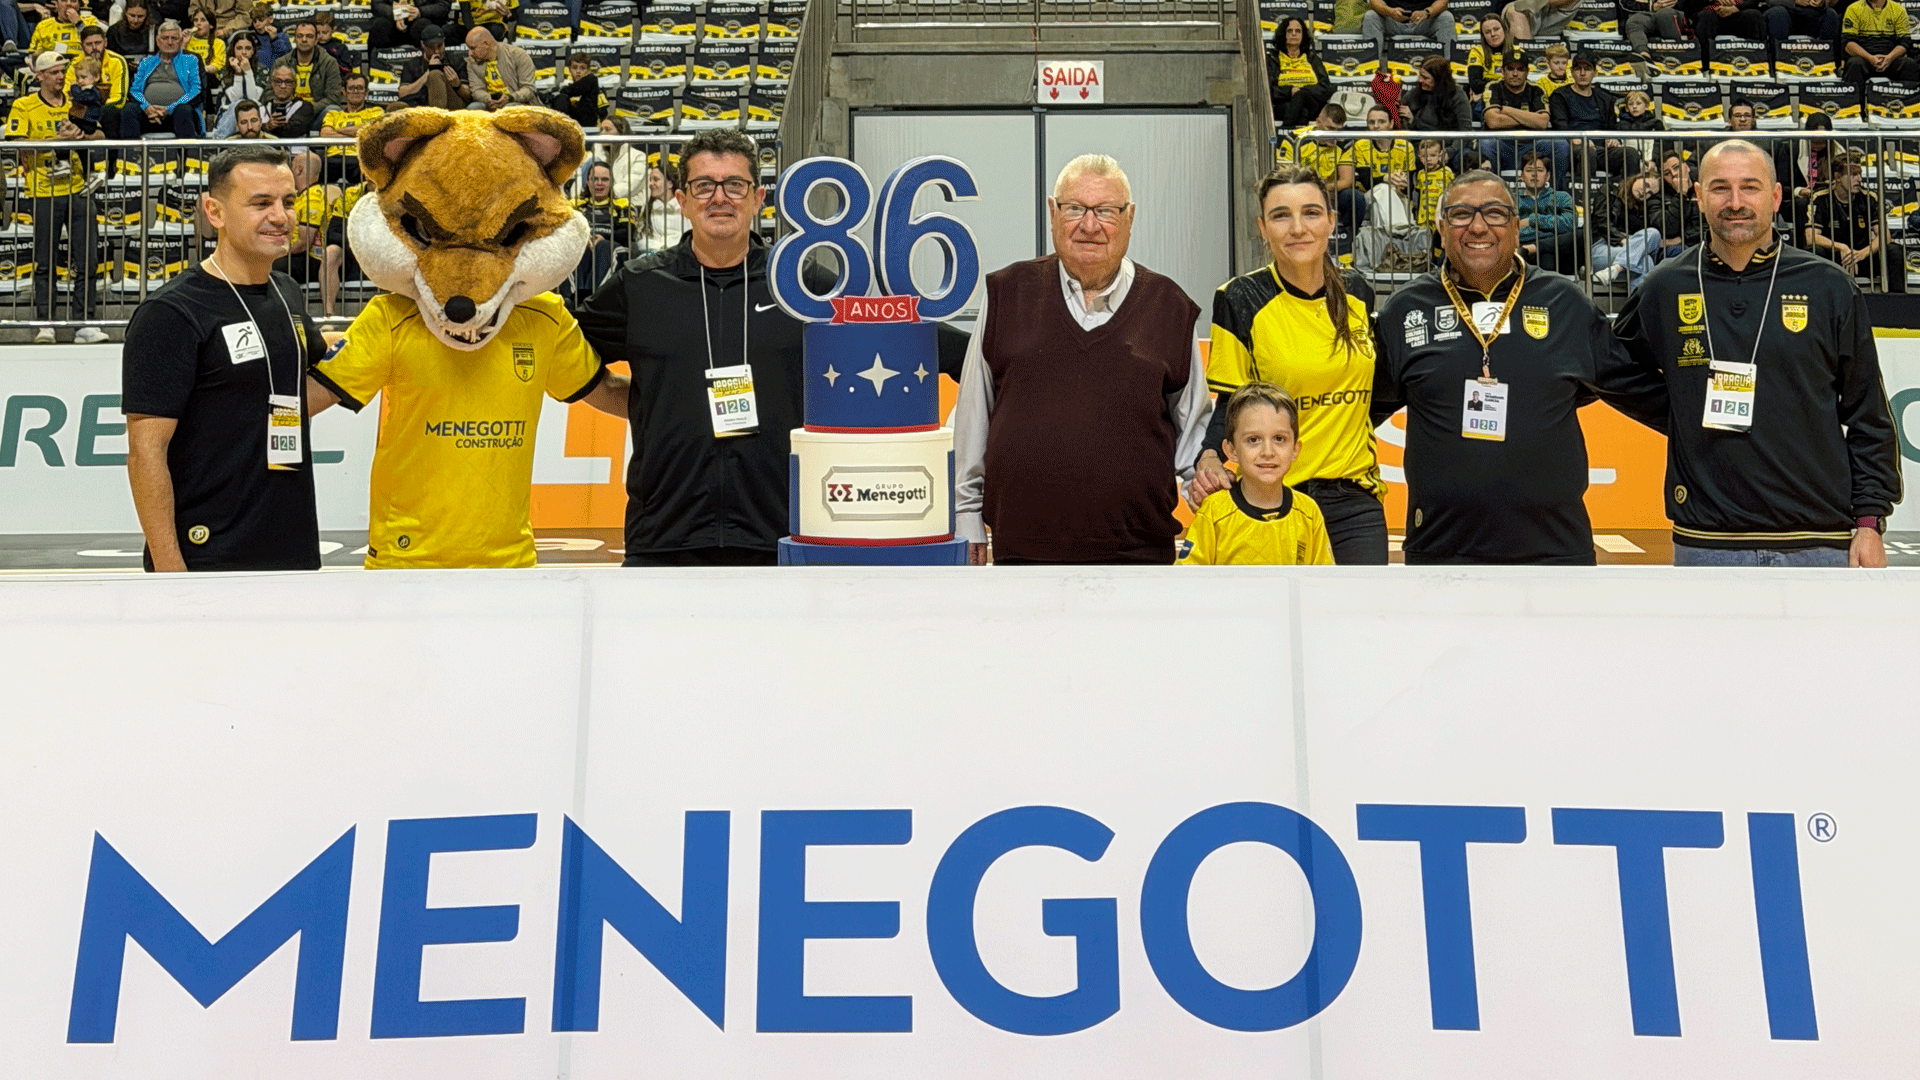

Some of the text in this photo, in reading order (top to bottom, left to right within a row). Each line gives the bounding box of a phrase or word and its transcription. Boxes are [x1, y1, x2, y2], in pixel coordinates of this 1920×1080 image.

[700, 46, 746, 54] RESERVADO
[1327, 42, 1374, 50] RESERVADO
[1781, 42, 1830, 50] RESERVADO
[1042, 66, 1099, 87] SAIDA
[622, 89, 670, 98] RESERVADO
[1669, 86, 1717, 94] RESERVADO
[1736, 87, 1785, 95] RESERVADO
[766, 155, 982, 322] 86
[850, 302, 907, 319] ANOS
[425, 420, 527, 437] MENEGOTTI
[455, 436, 524, 449] CONSTRUÇÃO
[856, 486, 926, 504] Menegotti
